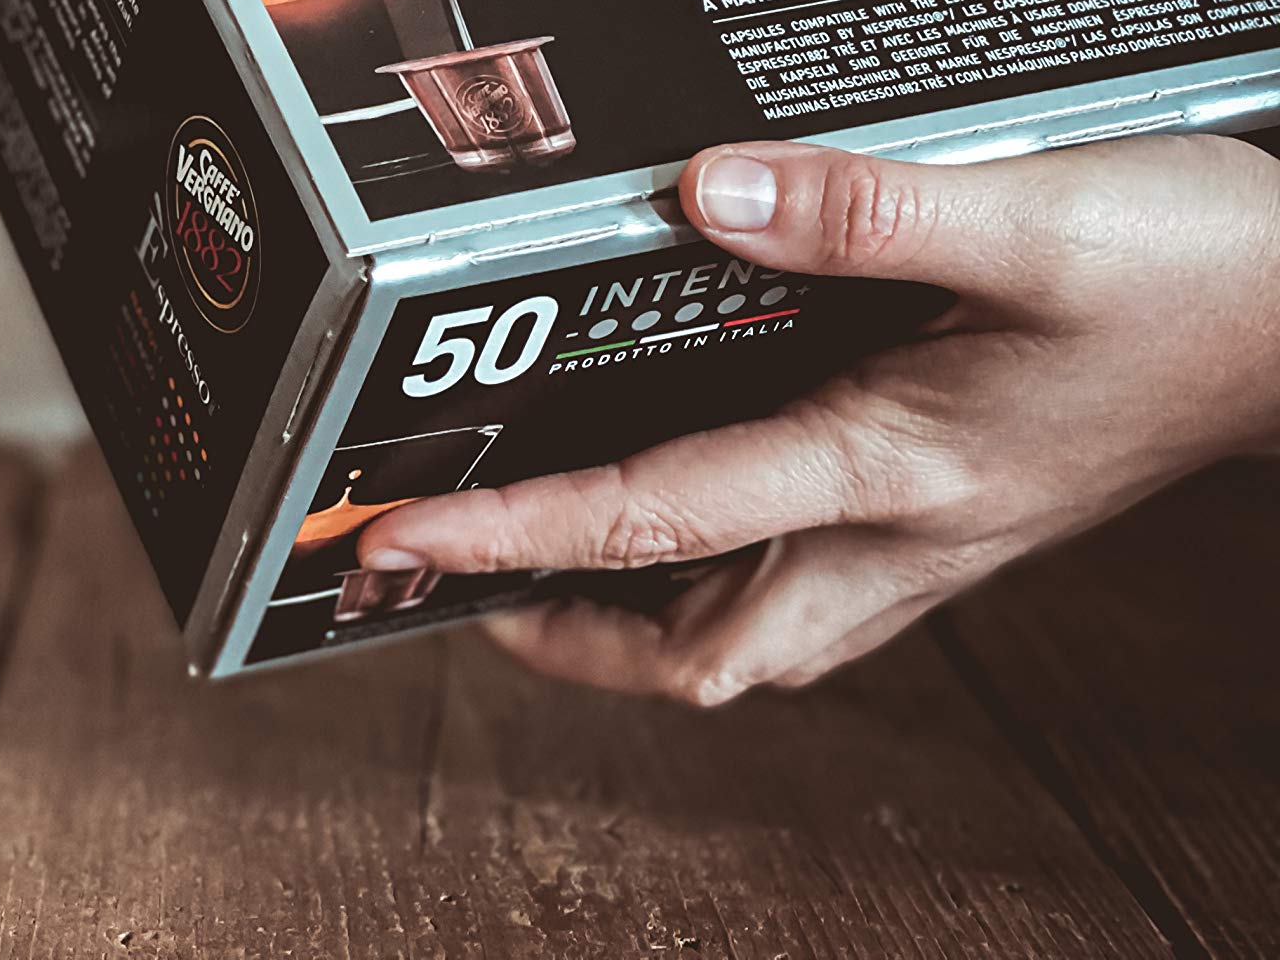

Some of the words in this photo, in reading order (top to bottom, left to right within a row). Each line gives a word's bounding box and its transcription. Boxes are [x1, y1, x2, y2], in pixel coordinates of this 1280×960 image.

[721, 24, 785, 44] CAPSULES
[791, 8, 869, 31] COMPATIBLE
[873, 2, 907, 16] WITH
[729, 32, 830, 59] MANUFACTURED
[837, 28, 854, 40] BY
[962, 3, 987, 16] LES
[746, 76, 770, 89] DIE
[780, 63, 838, 83] KAPSELN
[849, 56, 880, 70] SIND
[891, 42, 950, 62] GEEIGNET
[962, 35, 990, 49] FÜR
[999, 29, 1022, 42] DIE
[1031, 15, 1103, 36] MASCHINEN
[755, 68, 901, 104] HAUSHALTSMASCHINEN
[905, 63, 932, 76] DER
[936, 53, 981, 70] MARKE
[1082, 30, 1106, 43] LAS
[1176, 13, 1203, 26] SON
[860, 39, 877, 51] ET
[883, 33, 914, 48] AVEC
[916, 28, 941, 41] LES
[944, 16, 1008, 36] MACHINES
[1010, 11, 1022, 24] À
[1023, 5, 1065, 21] USAGE
[764, 98, 830, 120] MÁQUINAS
[944, 75, 956, 85] Y
[955, 70, 983, 83] CON
[982, 65, 1007, 78] LAS
[1006, 53, 1070, 73] MÁQUINAS
[1070, 48, 1105, 62] PARA
[1103, 43, 1128, 56] USO
[1128, 30, 1195, 51] DOMÉSTICO
[1195, 27, 1214, 39] DE
[1212, 24, 1231, 36] LA
[1229, 17, 1272, 32] MARCA
[176, 144, 254, 251] VERGNANO
[176, 201, 241, 292] 1882
[401, 295, 559, 397] 50
[579, 259, 785, 316] INTEN
[548, 343, 672, 375] PRODOTTO
[683, 335, 708, 349] IN
[719, 319, 795, 343] ITALIA
